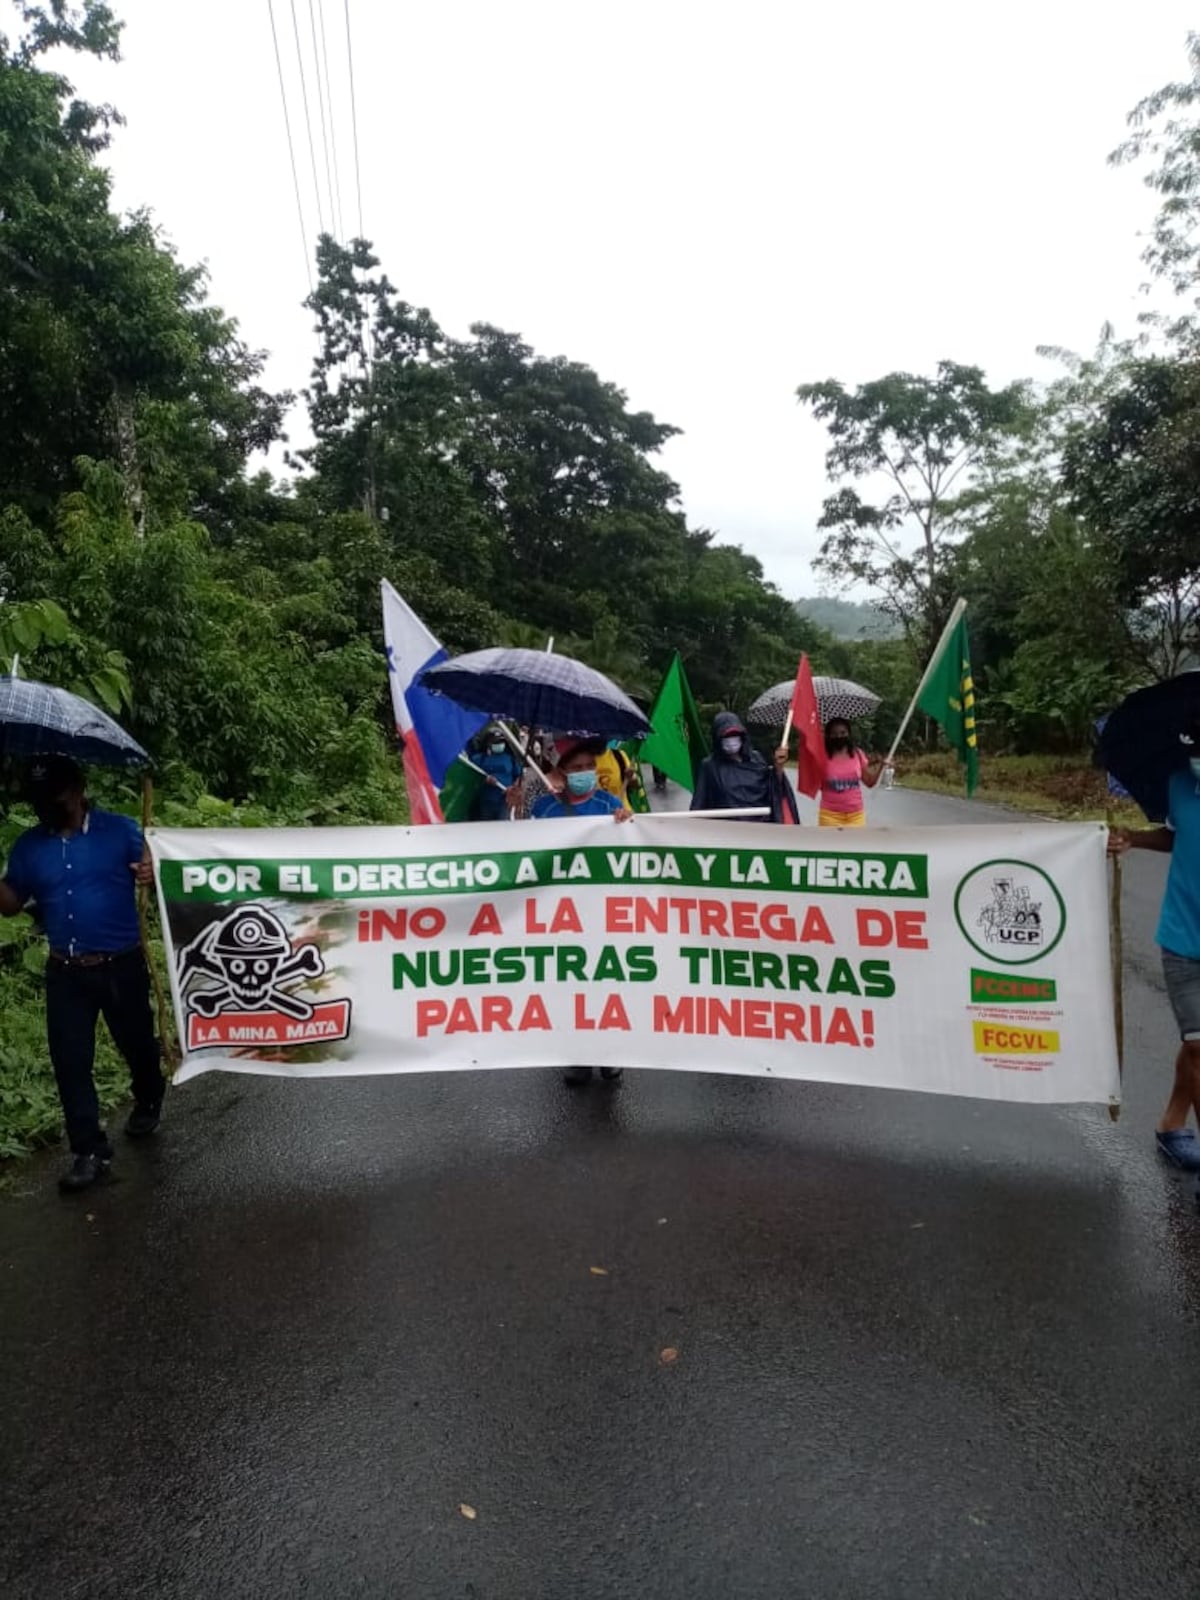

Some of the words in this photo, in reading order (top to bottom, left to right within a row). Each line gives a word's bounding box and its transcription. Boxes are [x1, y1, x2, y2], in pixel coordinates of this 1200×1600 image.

[182, 864, 262, 893] POR
[278, 864, 319, 892] EL
[332, 859, 500, 892] DERECHO
[515, 857, 538, 883] A
[552, 853, 591, 879] LA
[607, 852, 681, 880] VIDA
[695, 854, 717, 881] Y
[730, 855, 770, 884] LA
[785, 857, 916, 891] TIERRA
[469, 903, 503, 936] A
[525, 897, 583, 934] LA
[605, 897, 835, 945] ENTREGA
[856, 908, 929, 949] DE
[1000, 929, 1039, 941] UCP
[392, 946, 658, 990] NUESTRAS
[680, 947, 896, 998] TIERRAS
[196, 1027, 221, 1042] LA
[229, 1025, 278, 1041] MINA
[286, 1020, 339, 1039] MATA
[416, 994, 552, 1037] PARA
[575, 994, 631, 1031] LA
[653, 995, 875, 1048] MINERIA!
[982, 1029, 1048, 1050] FCCVL
